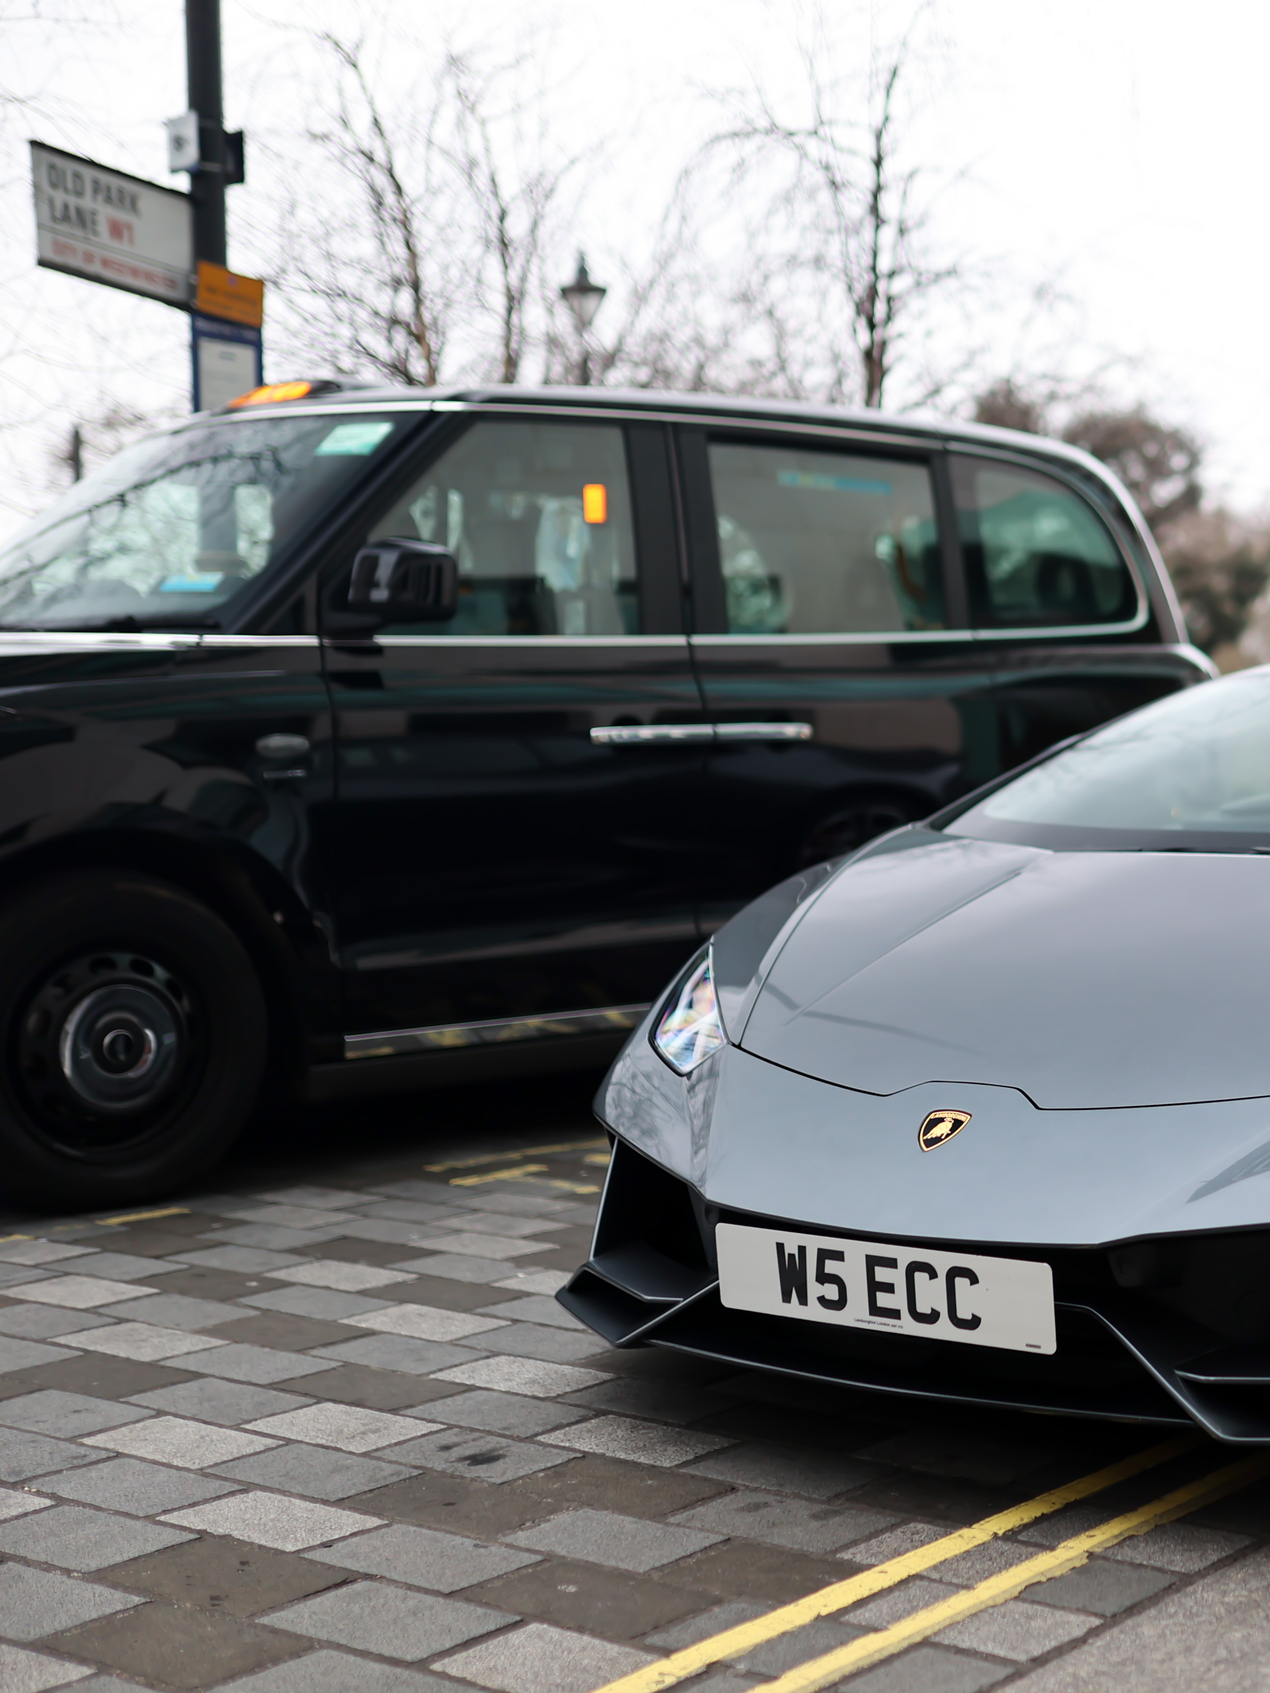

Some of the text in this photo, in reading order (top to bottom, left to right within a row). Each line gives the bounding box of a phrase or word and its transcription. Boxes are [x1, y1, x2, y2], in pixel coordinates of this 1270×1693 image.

[47, 162, 140, 217] OLD PARK
[49, 195, 134, 247] LANE W1
[775, 1242, 982, 1331] W5 ECC
